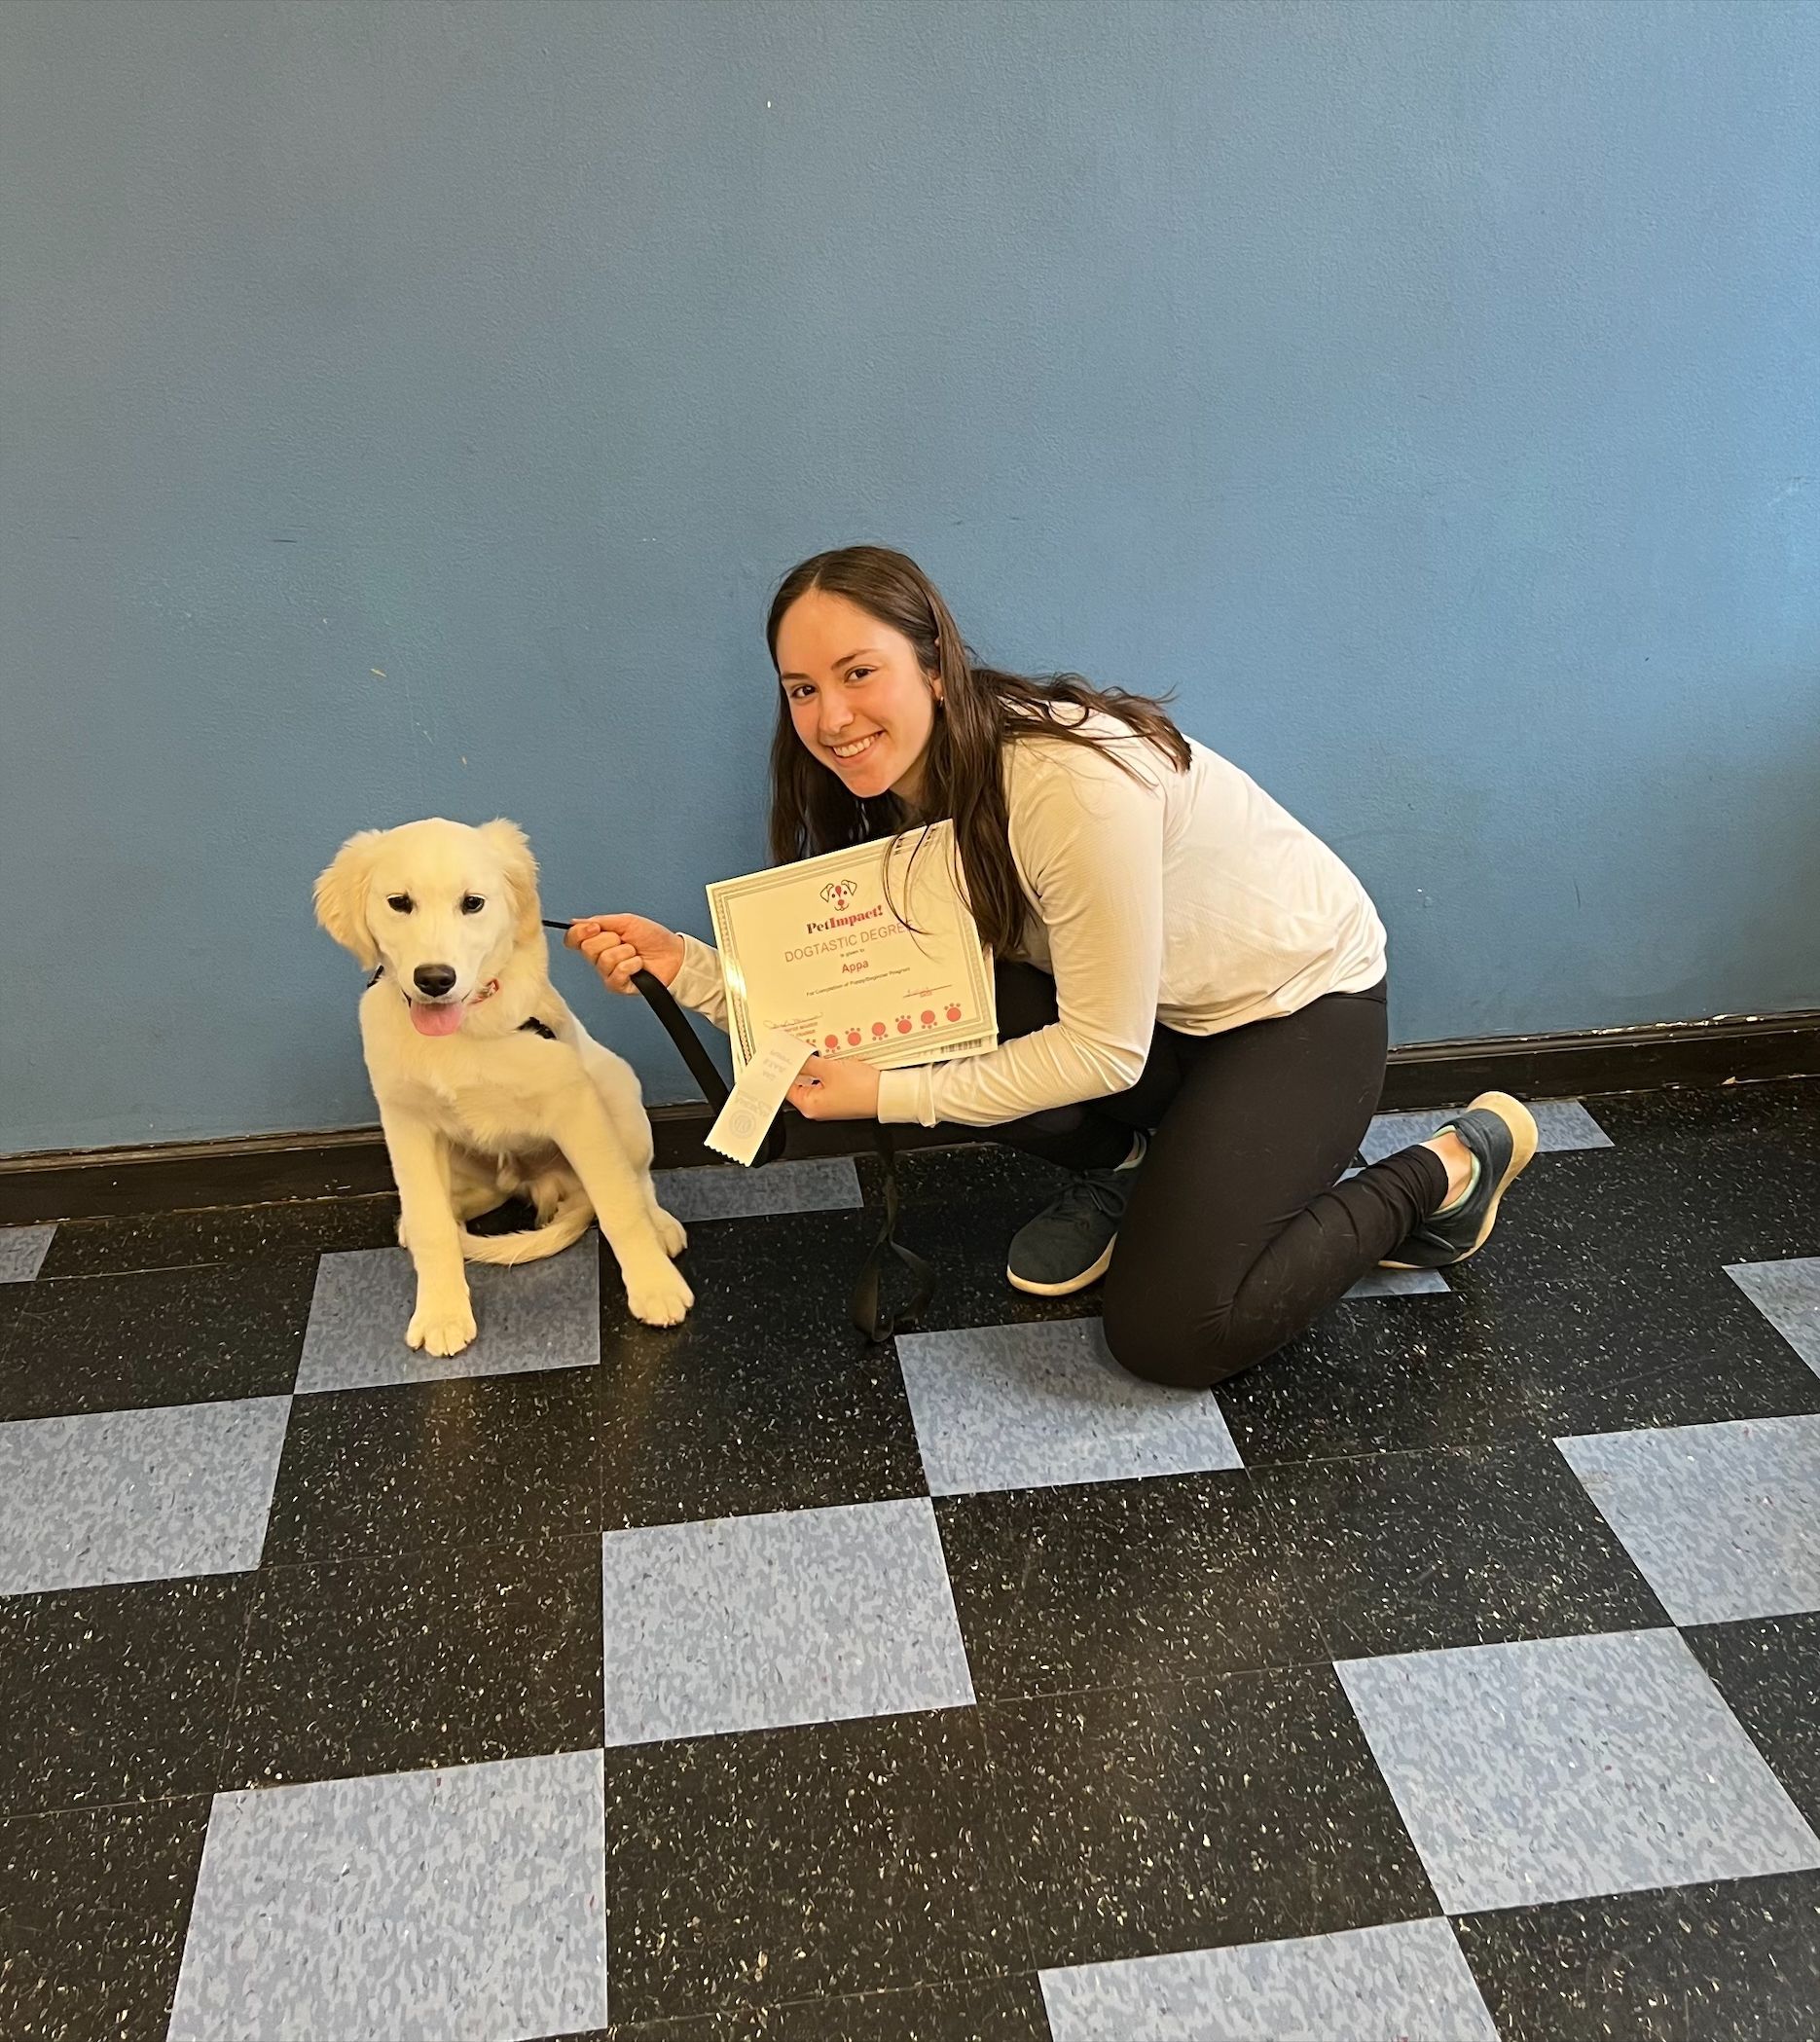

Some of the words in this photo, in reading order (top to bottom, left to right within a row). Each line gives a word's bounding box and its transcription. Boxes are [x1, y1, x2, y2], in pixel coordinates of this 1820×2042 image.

[806, 905, 883, 934] PetImpact!
[784, 934, 857, 963] DOGTASTIC
[842, 961, 869, 973] Appa
